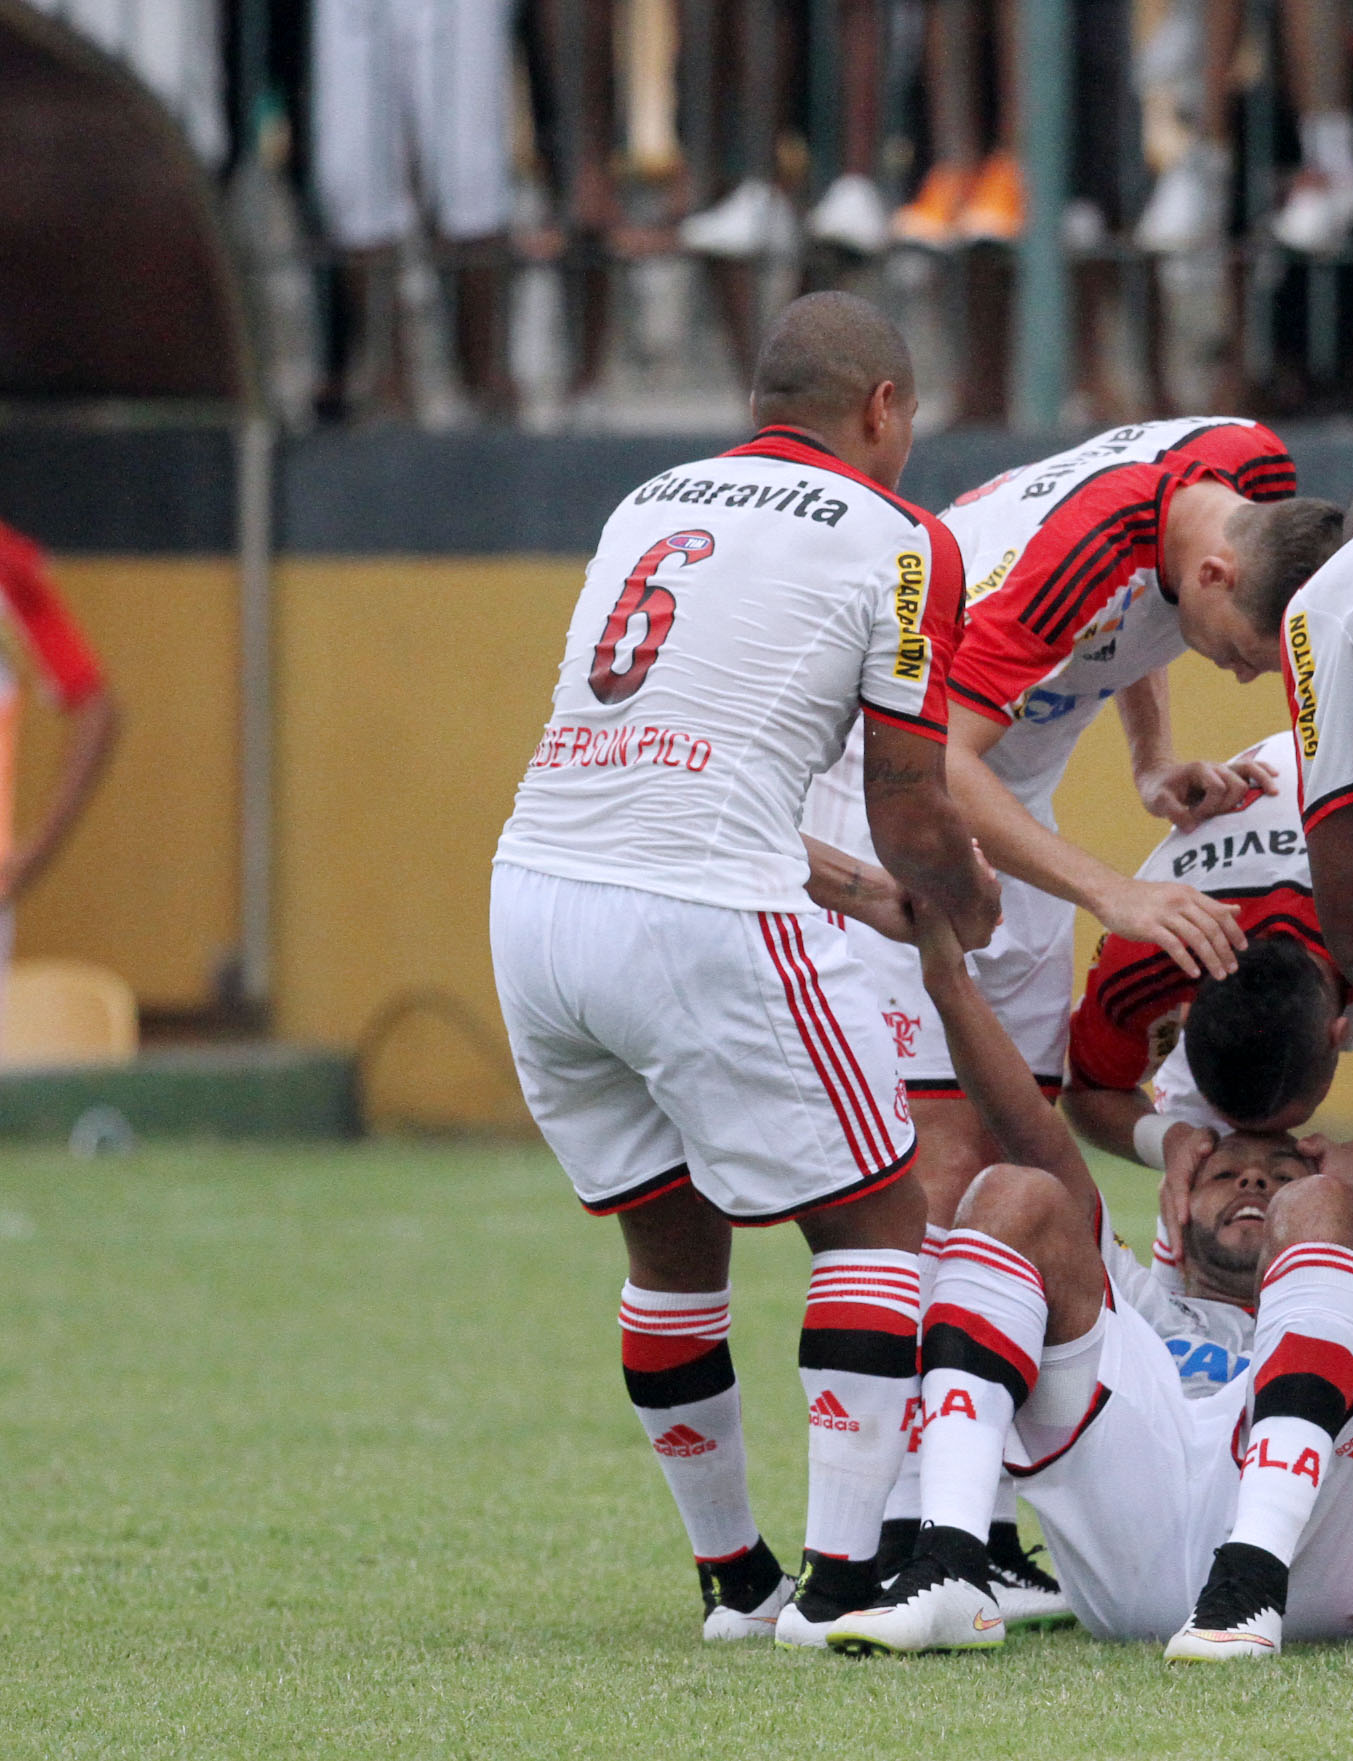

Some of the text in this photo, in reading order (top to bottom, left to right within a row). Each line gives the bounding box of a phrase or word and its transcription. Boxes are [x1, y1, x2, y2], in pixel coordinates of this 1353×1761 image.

[634, 471, 848, 529] Guaravita
[588, 528, 716, 706] 6
[527, 725, 712, 772] DERSON PICO
[920, 1388, 977, 1430] LA
[653, 1439, 718, 1458] adidas
